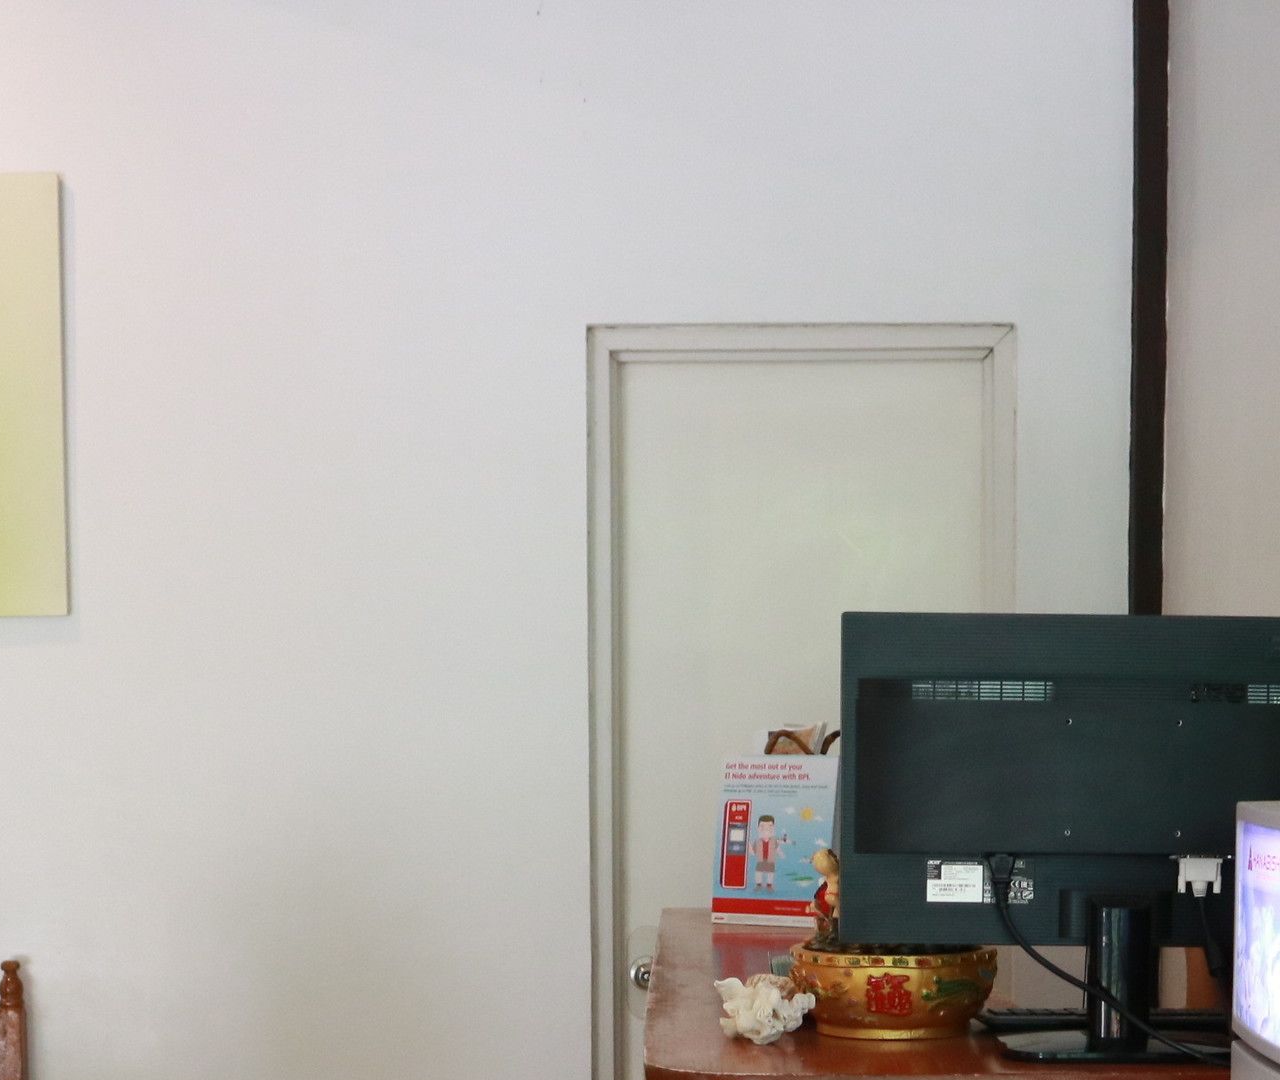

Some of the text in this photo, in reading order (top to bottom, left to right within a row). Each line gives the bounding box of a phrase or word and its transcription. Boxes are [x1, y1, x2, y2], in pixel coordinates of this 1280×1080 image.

[788, 765, 803, 773] your
[731, 772, 747, 780] Nido
[782, 772, 797, 780] with
